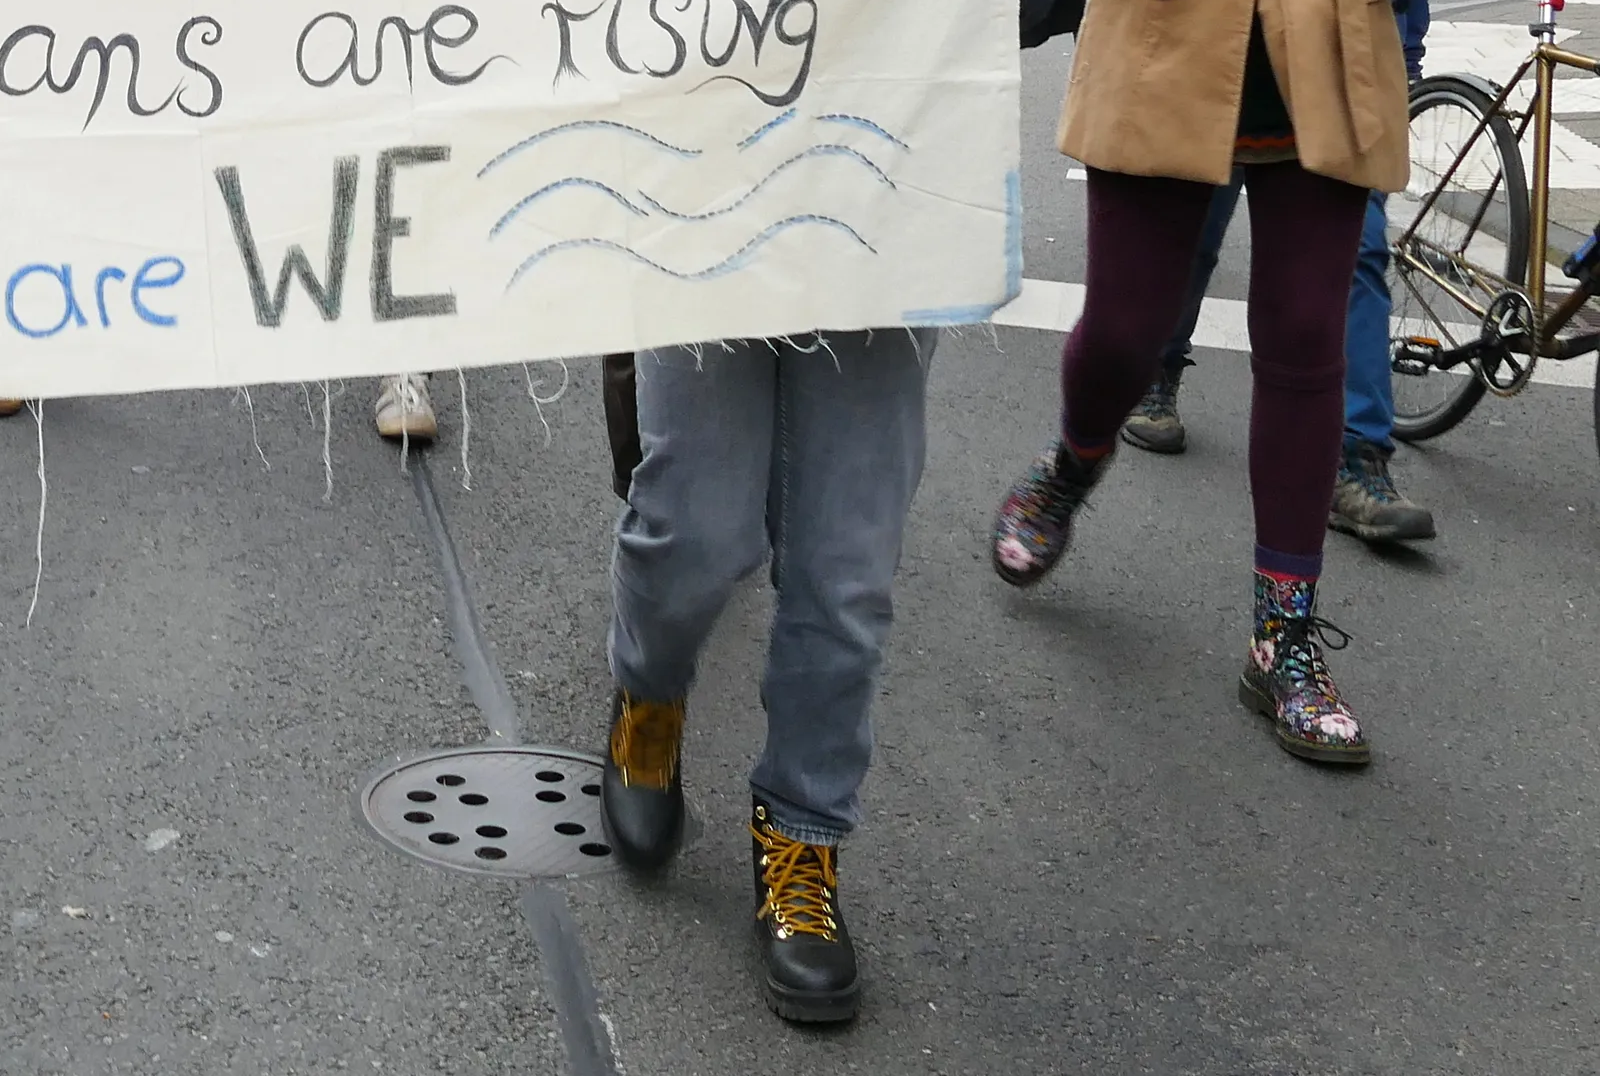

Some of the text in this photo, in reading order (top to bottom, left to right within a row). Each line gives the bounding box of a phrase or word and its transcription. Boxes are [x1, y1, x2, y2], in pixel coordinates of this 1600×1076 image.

[296, 4, 522, 95] are
[4, 254, 186, 338] are
[215, 144, 457, 329] WE
